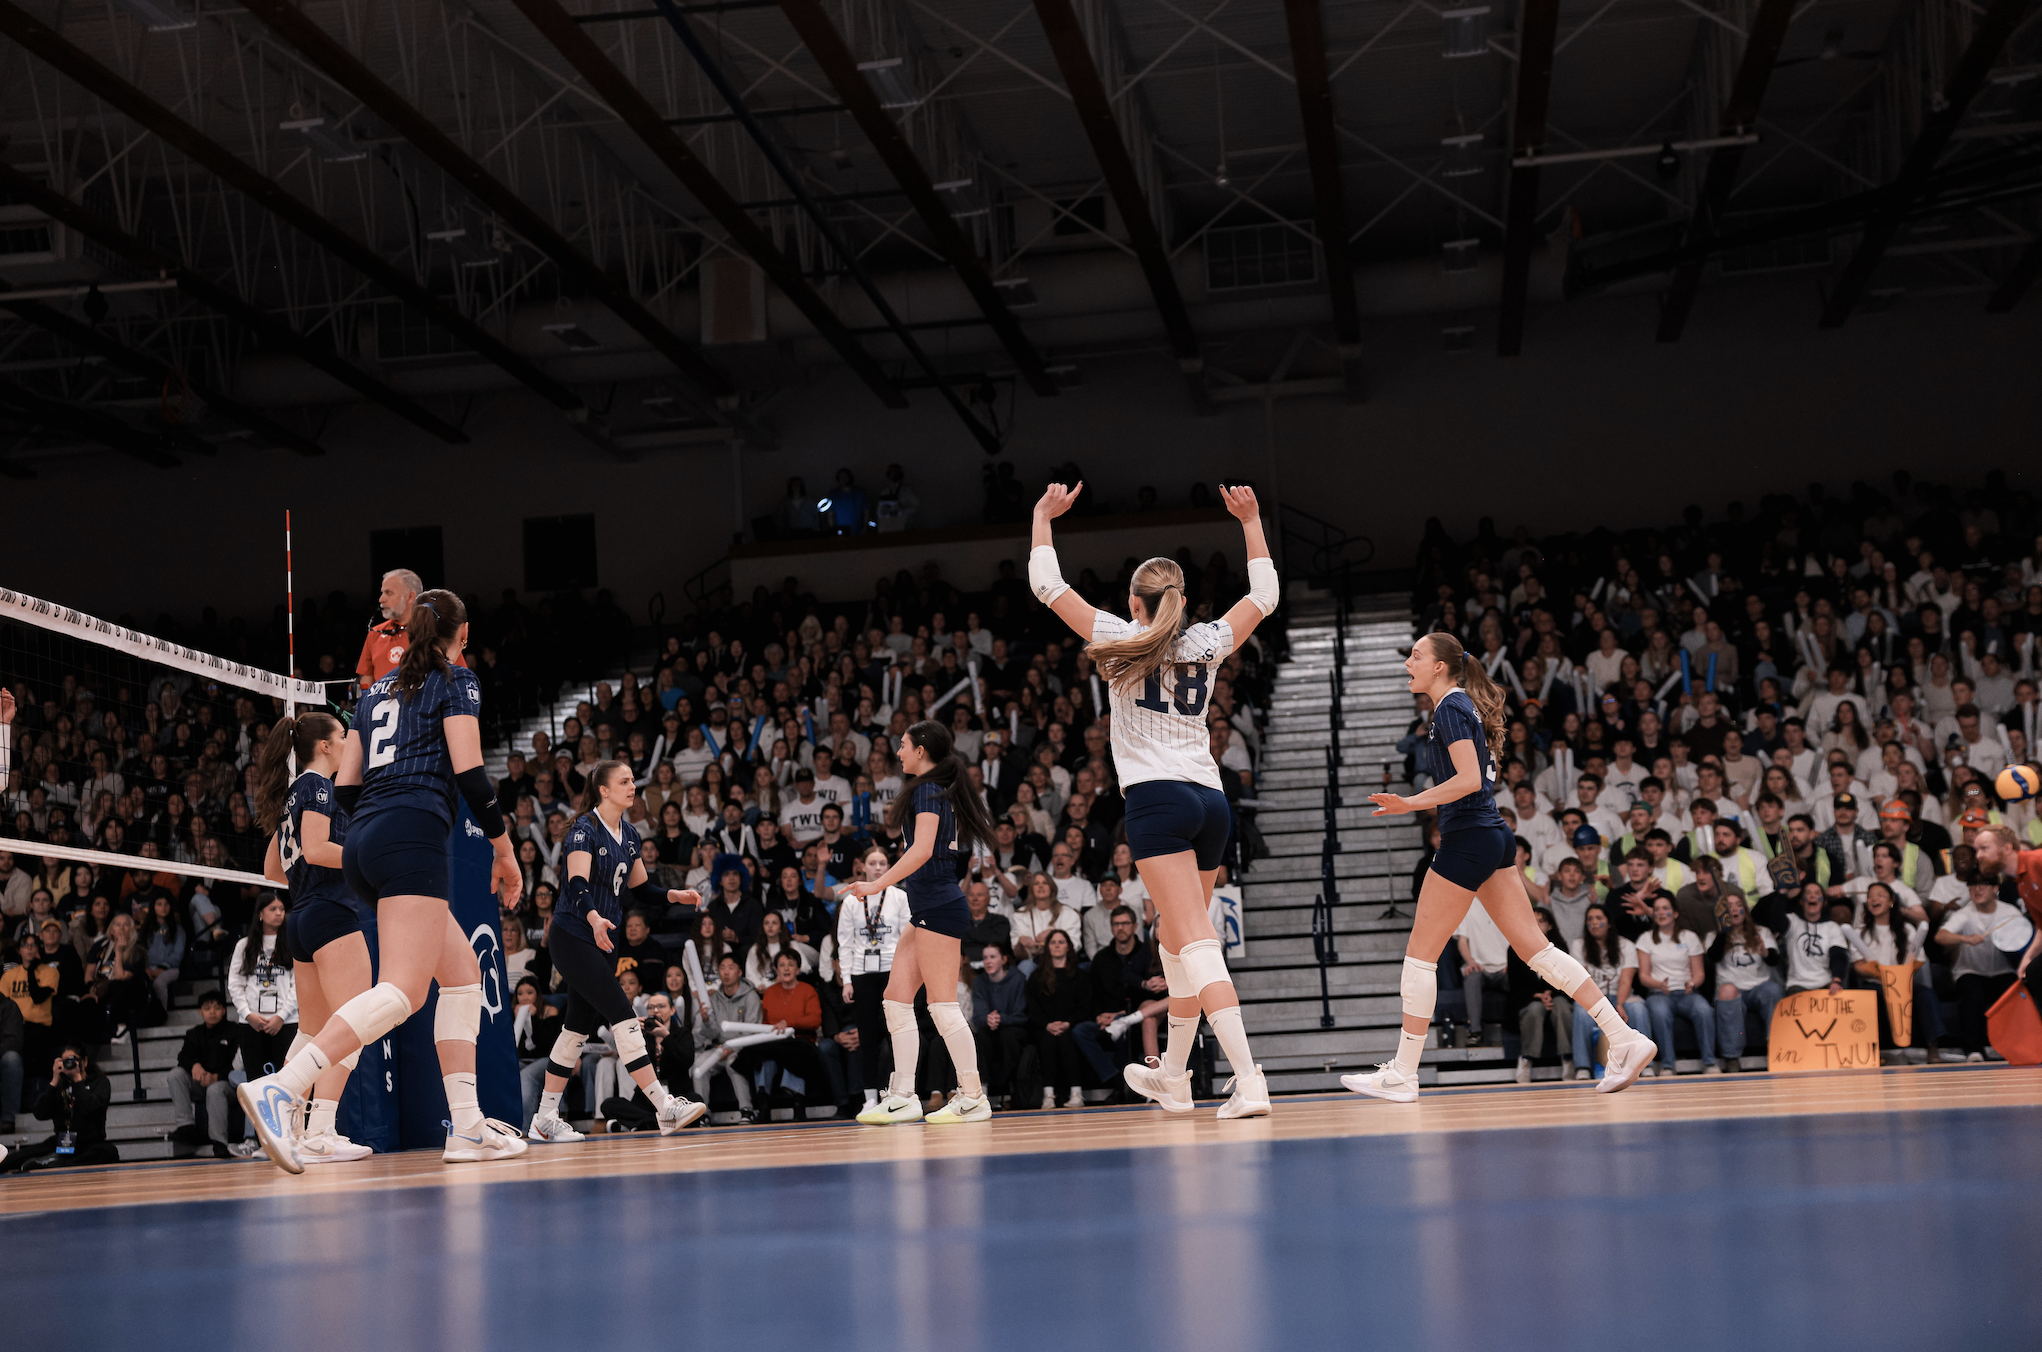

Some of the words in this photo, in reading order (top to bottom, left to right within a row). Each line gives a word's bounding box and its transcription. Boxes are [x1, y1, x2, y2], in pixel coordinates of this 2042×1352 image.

[1134, 662, 1208, 716] 18
[368, 698, 401, 770] 2
[613, 861, 628, 897] 6
[1780, 995, 1803, 1018] WE
[1809, 997, 1829, 1014] PUT
[1833, 997, 1856, 1015] THE
[1795, 1018, 1838, 1042] W
[1773, 1047, 1804, 1064] in
[1815, 1041, 1878, 1070] TWU!
